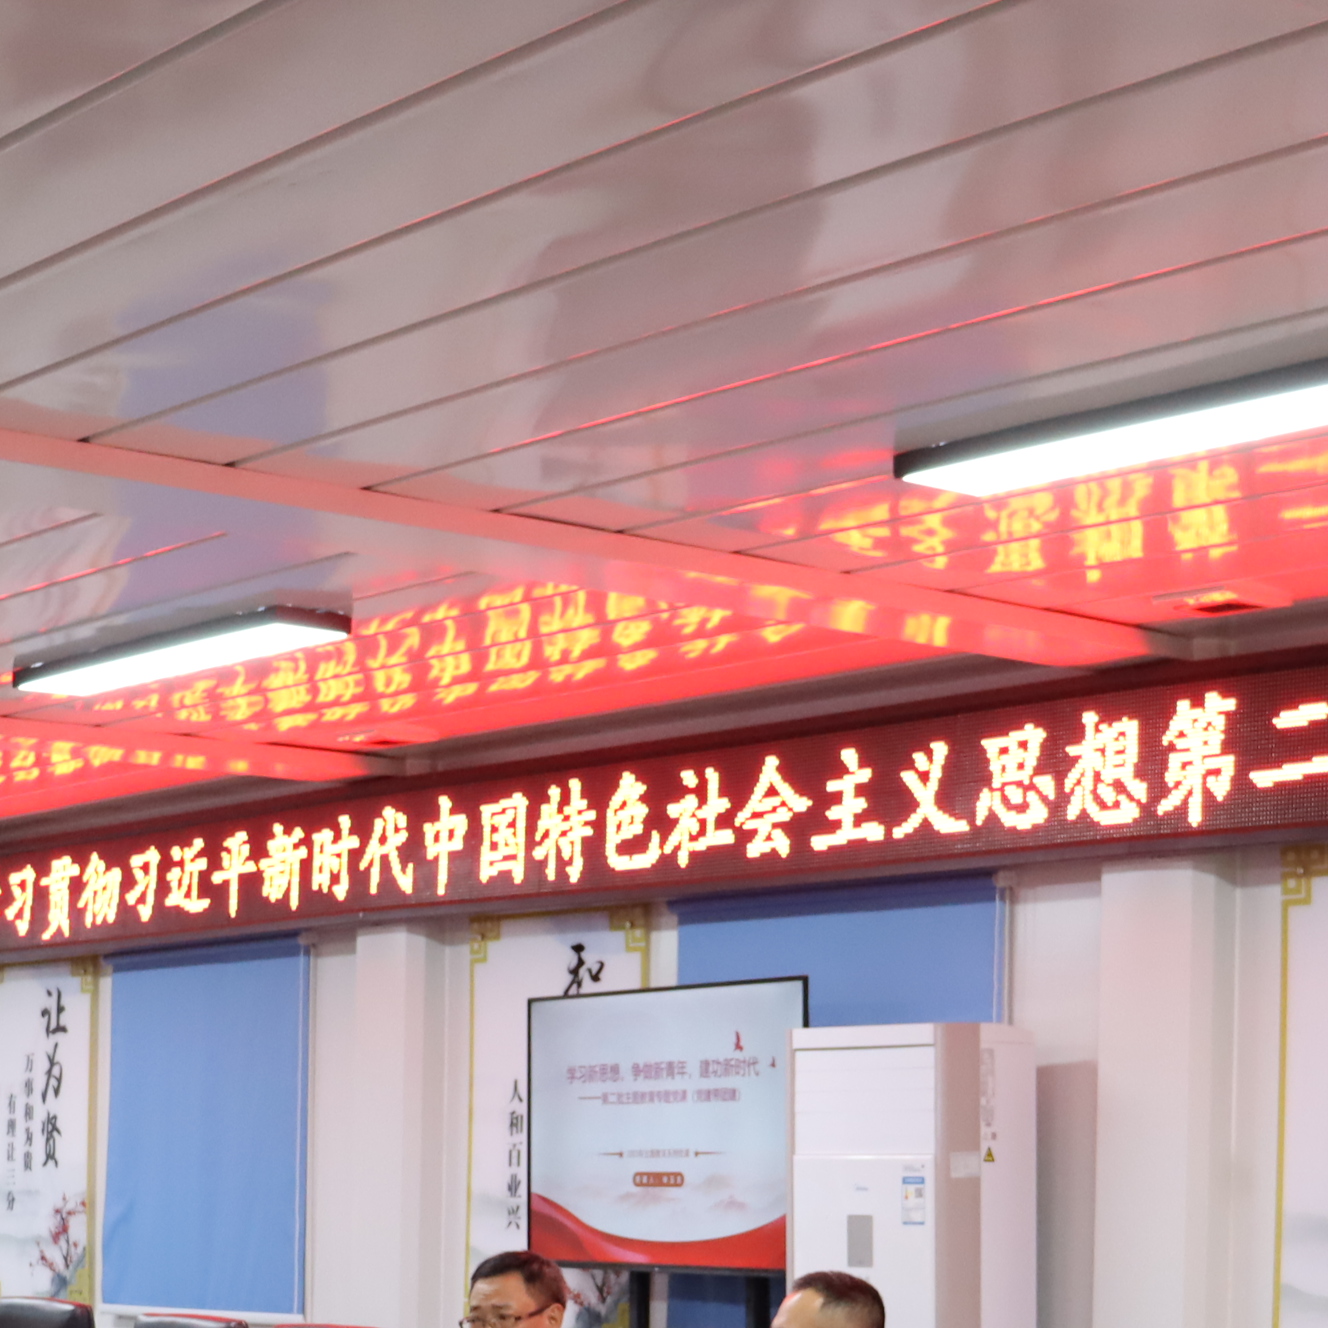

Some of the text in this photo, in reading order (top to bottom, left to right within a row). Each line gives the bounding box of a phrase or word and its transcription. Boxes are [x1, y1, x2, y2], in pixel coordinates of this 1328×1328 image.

[41, 987, 68, 1168] 让为贤
[506, 1078, 524, 1230] 人和百业兴
